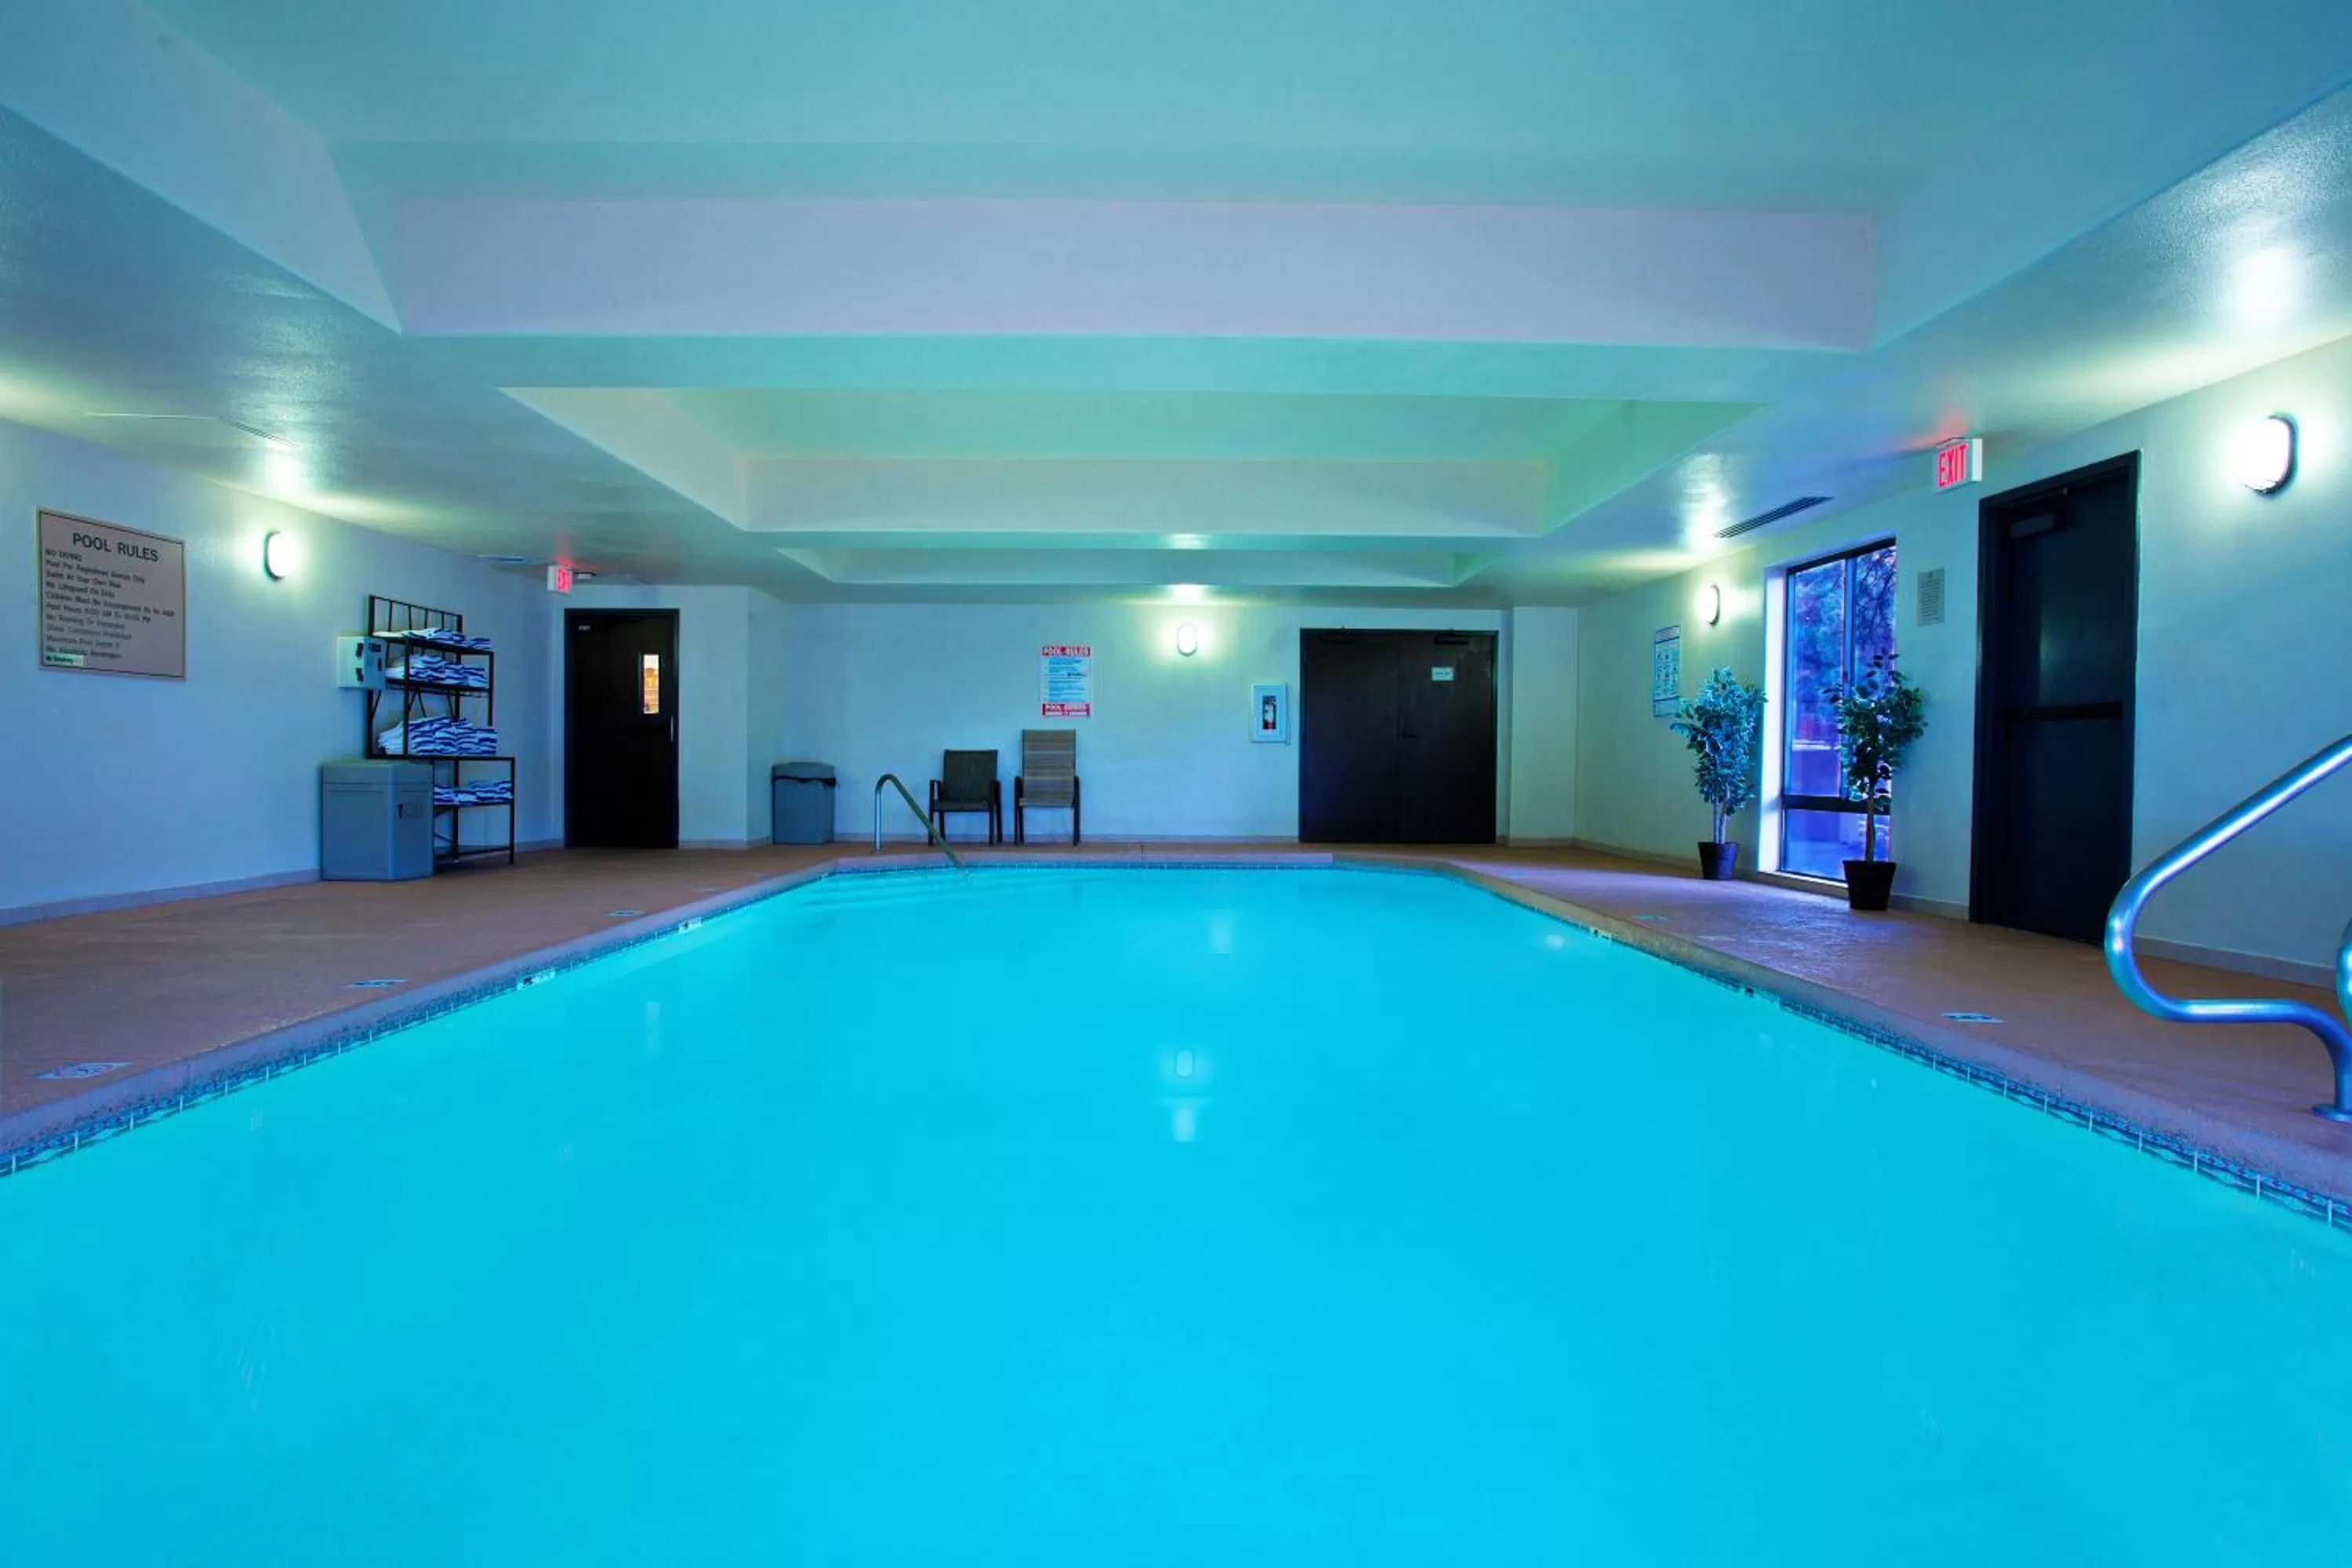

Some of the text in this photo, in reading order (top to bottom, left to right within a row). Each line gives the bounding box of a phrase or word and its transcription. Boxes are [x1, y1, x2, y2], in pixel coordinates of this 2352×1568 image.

[1939, 444, 1967, 488] EXIT
[45, 549, 58, 558] NO
[73, 533, 158, 562] POOL RULES
